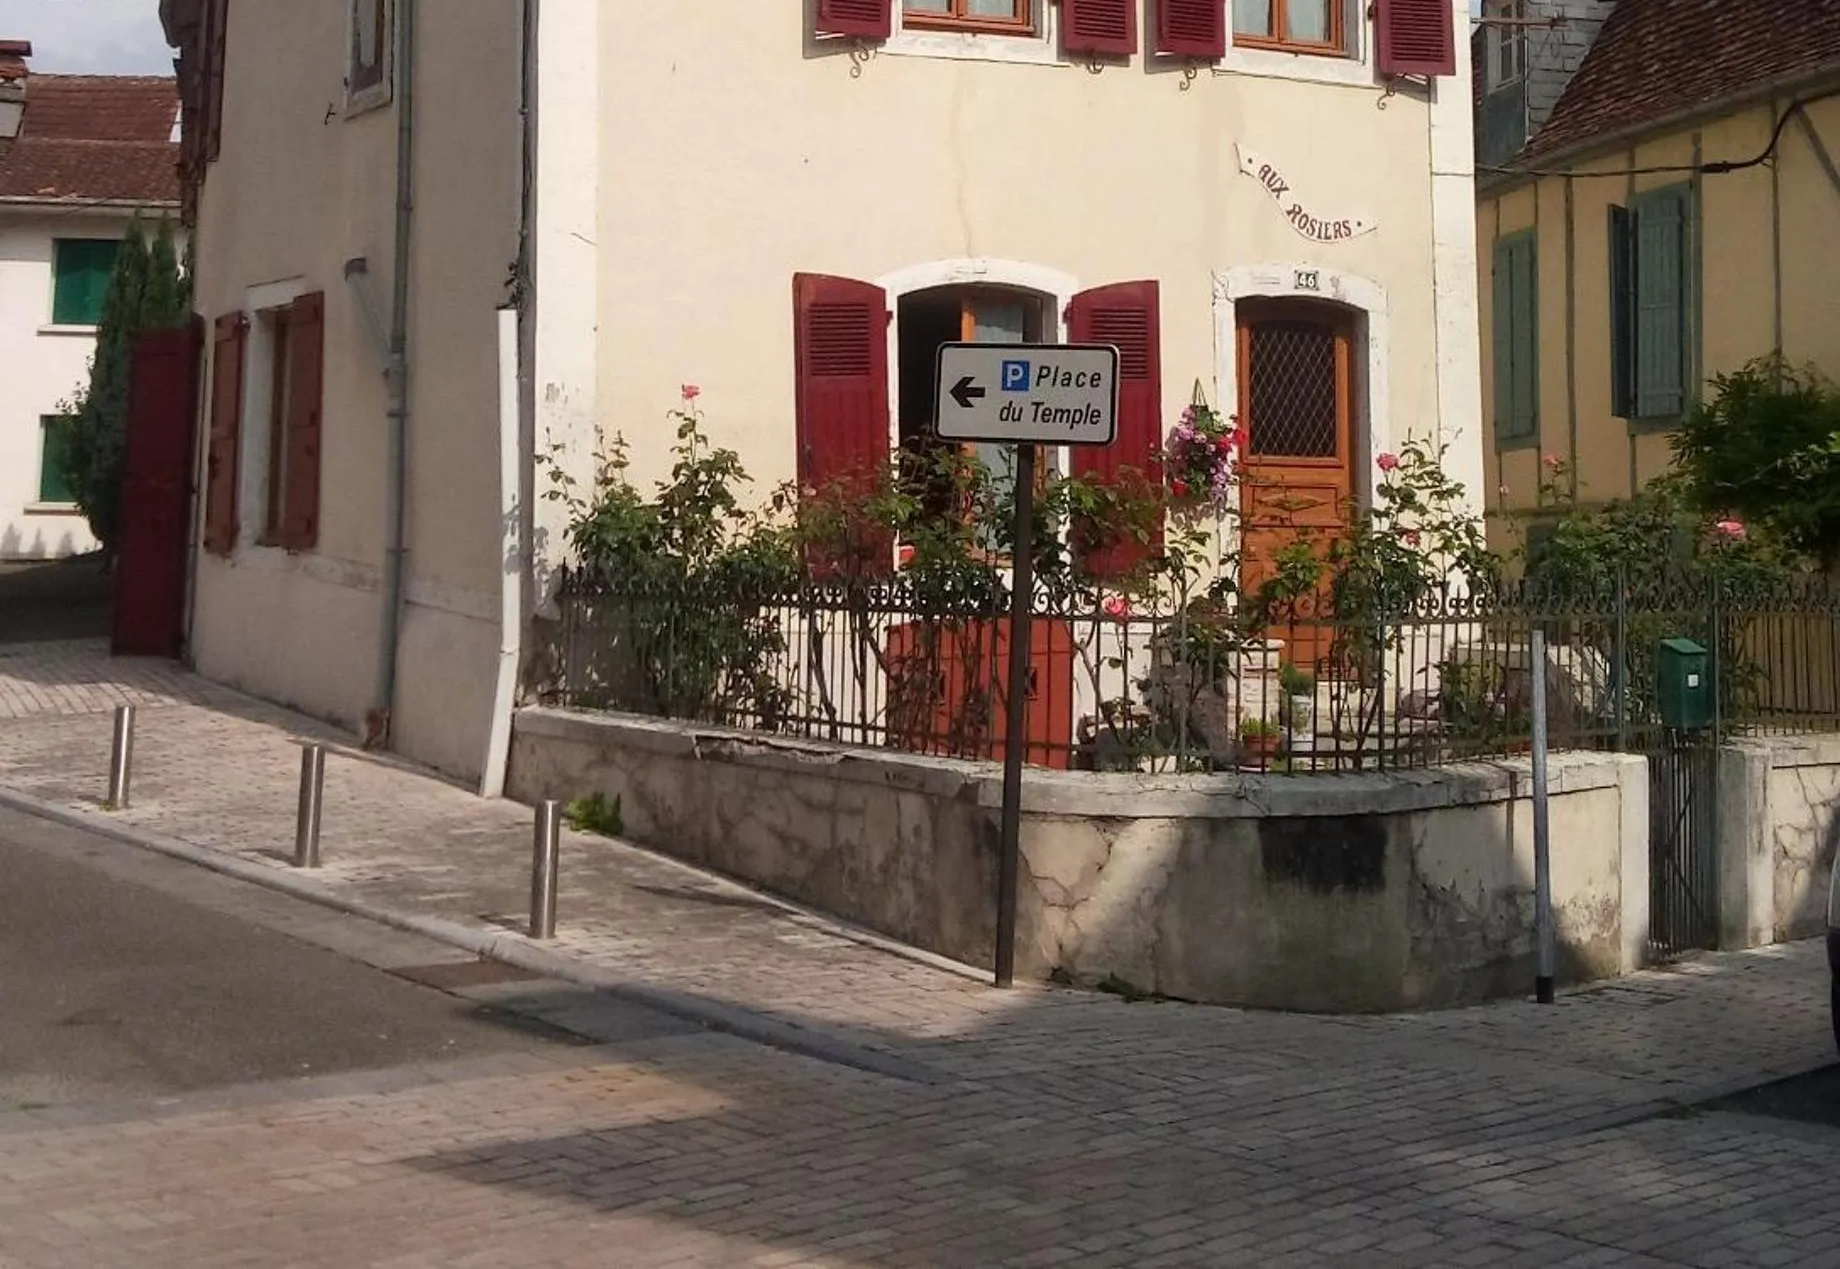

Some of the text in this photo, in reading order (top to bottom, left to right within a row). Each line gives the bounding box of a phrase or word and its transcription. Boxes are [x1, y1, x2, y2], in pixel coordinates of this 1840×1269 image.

[1259, 164, 1352, 240] AUX ROSIERS
[1299, 273, 1315, 287] 46
[1006, 363, 1101, 388] P Place
[999, 400, 1102, 430] du Temple
